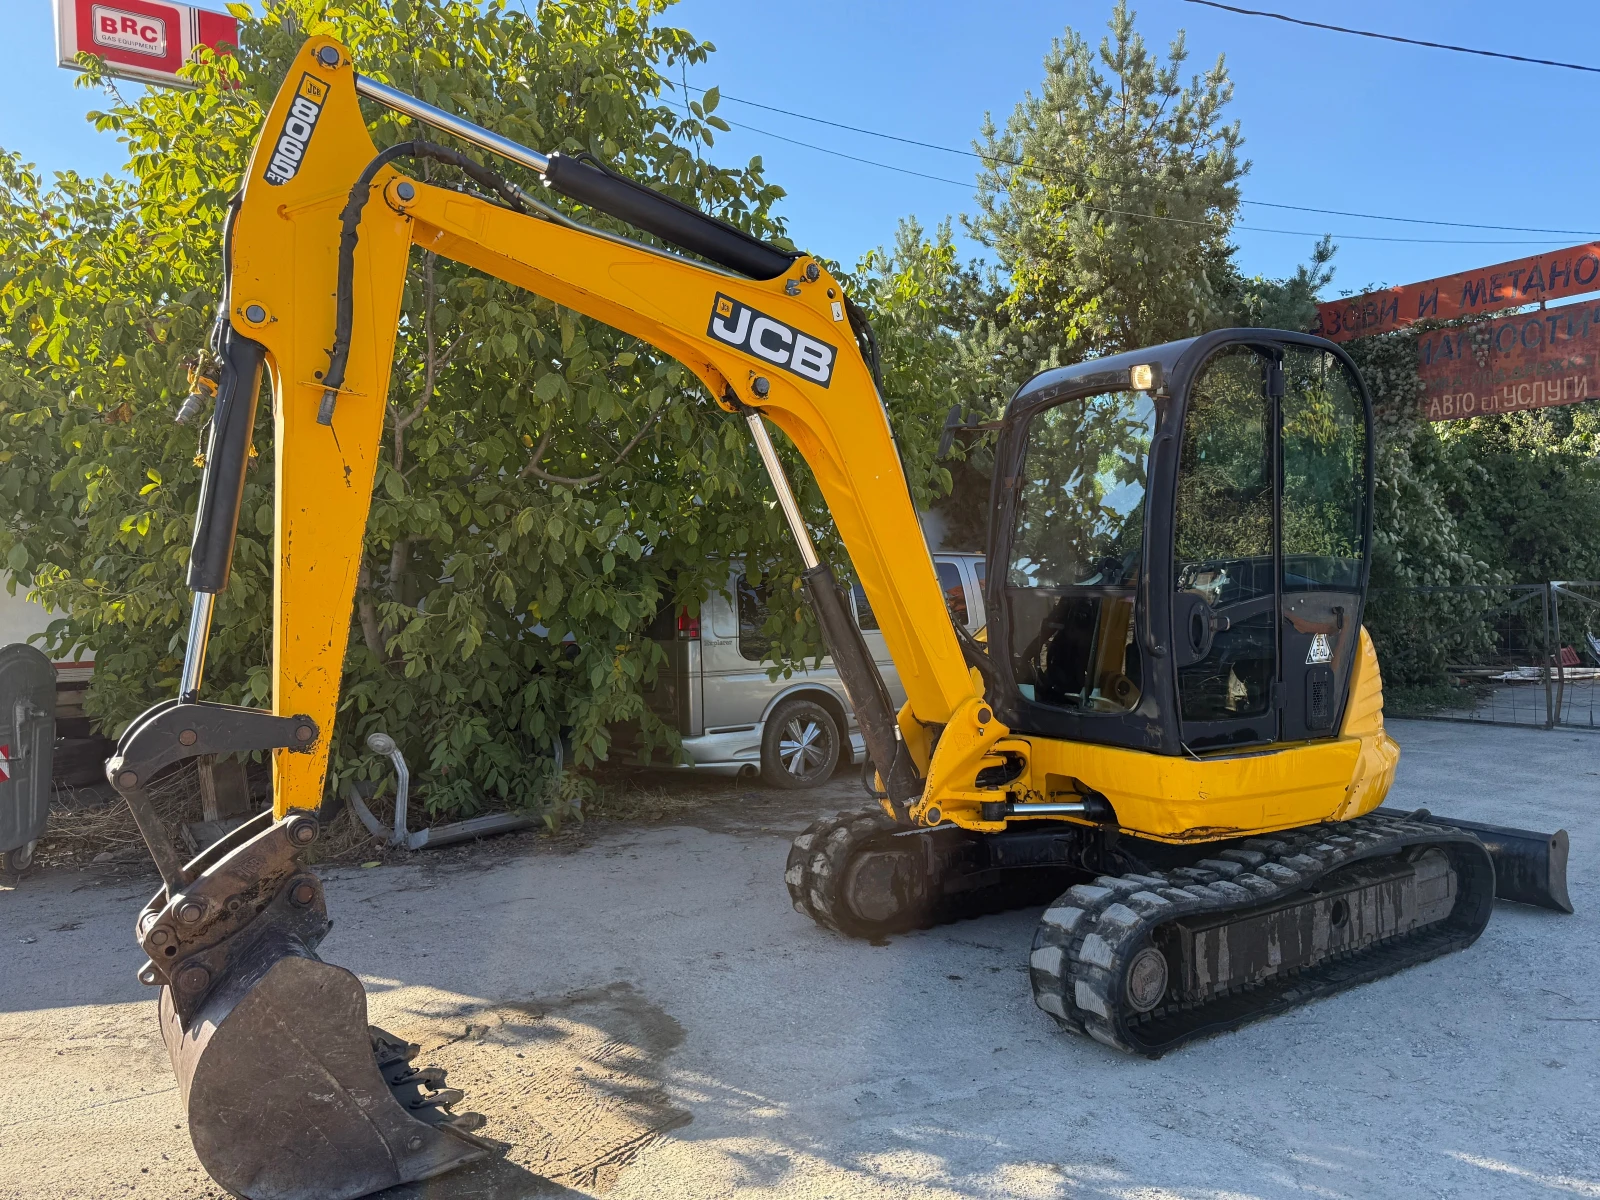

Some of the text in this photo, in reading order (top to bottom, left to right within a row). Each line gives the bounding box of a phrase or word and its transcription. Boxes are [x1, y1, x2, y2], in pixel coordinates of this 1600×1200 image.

[101, 16, 158, 43] BRC
[101, 34, 158, 51] GAS EQUIPMENT
[307, 83, 322, 96] JCB
[270, 97, 319, 179] 8065
[1418, 287, 1439, 317] И
[1459, 252, 1599, 309] МЕТАНО
[712, 307, 833, 382] JCB
[1429, 392, 1475, 418] АВТО
[1503, 375, 1588, 407] УСЛУГИ
